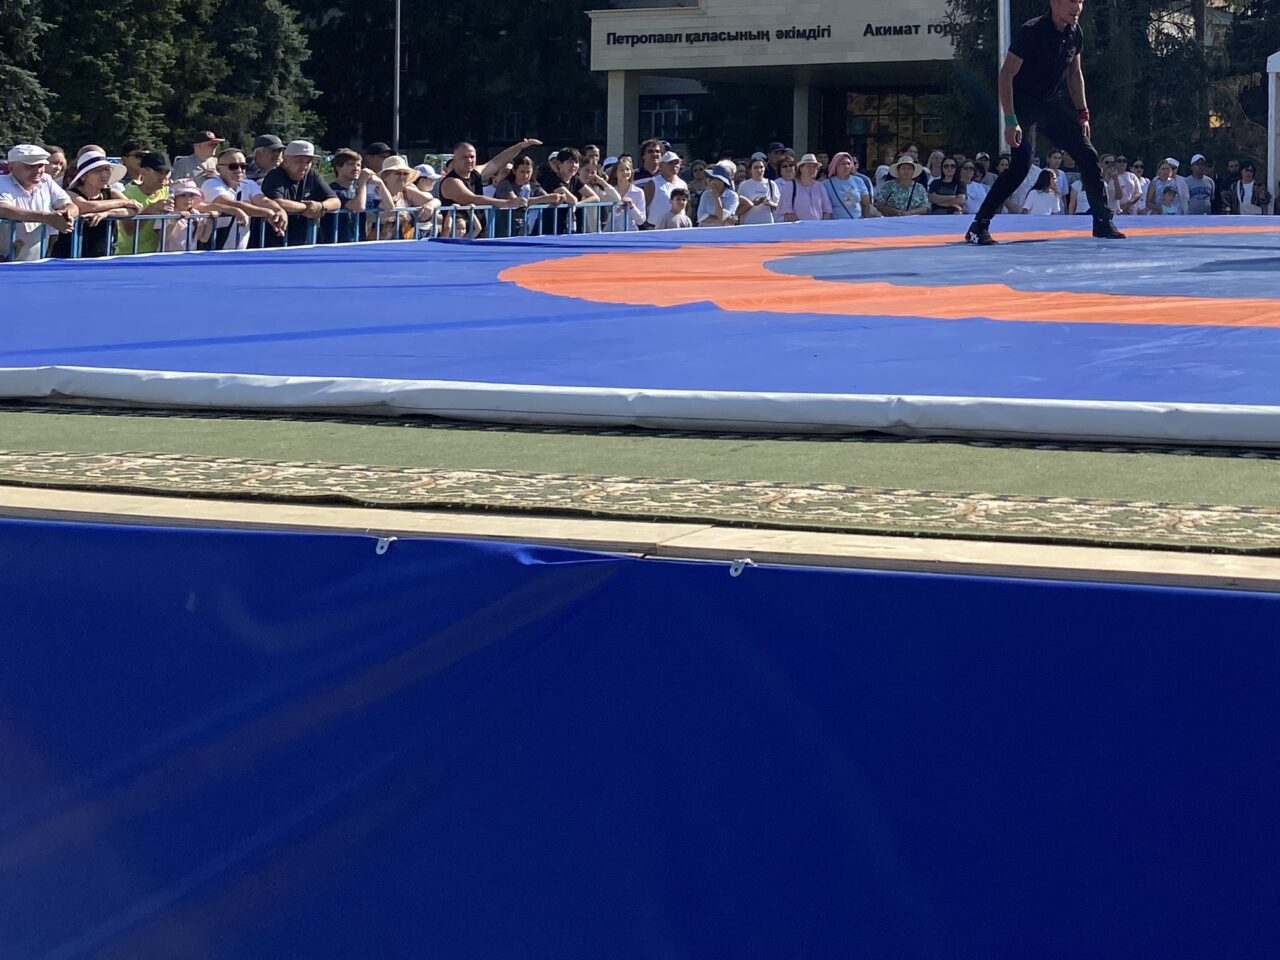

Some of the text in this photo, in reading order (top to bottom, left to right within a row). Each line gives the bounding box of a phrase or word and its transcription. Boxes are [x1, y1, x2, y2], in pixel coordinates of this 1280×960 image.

[606, 25, 832, 47] Петропавл қаласының әкімдігі
[863, 23, 963, 38] Акимат горо
